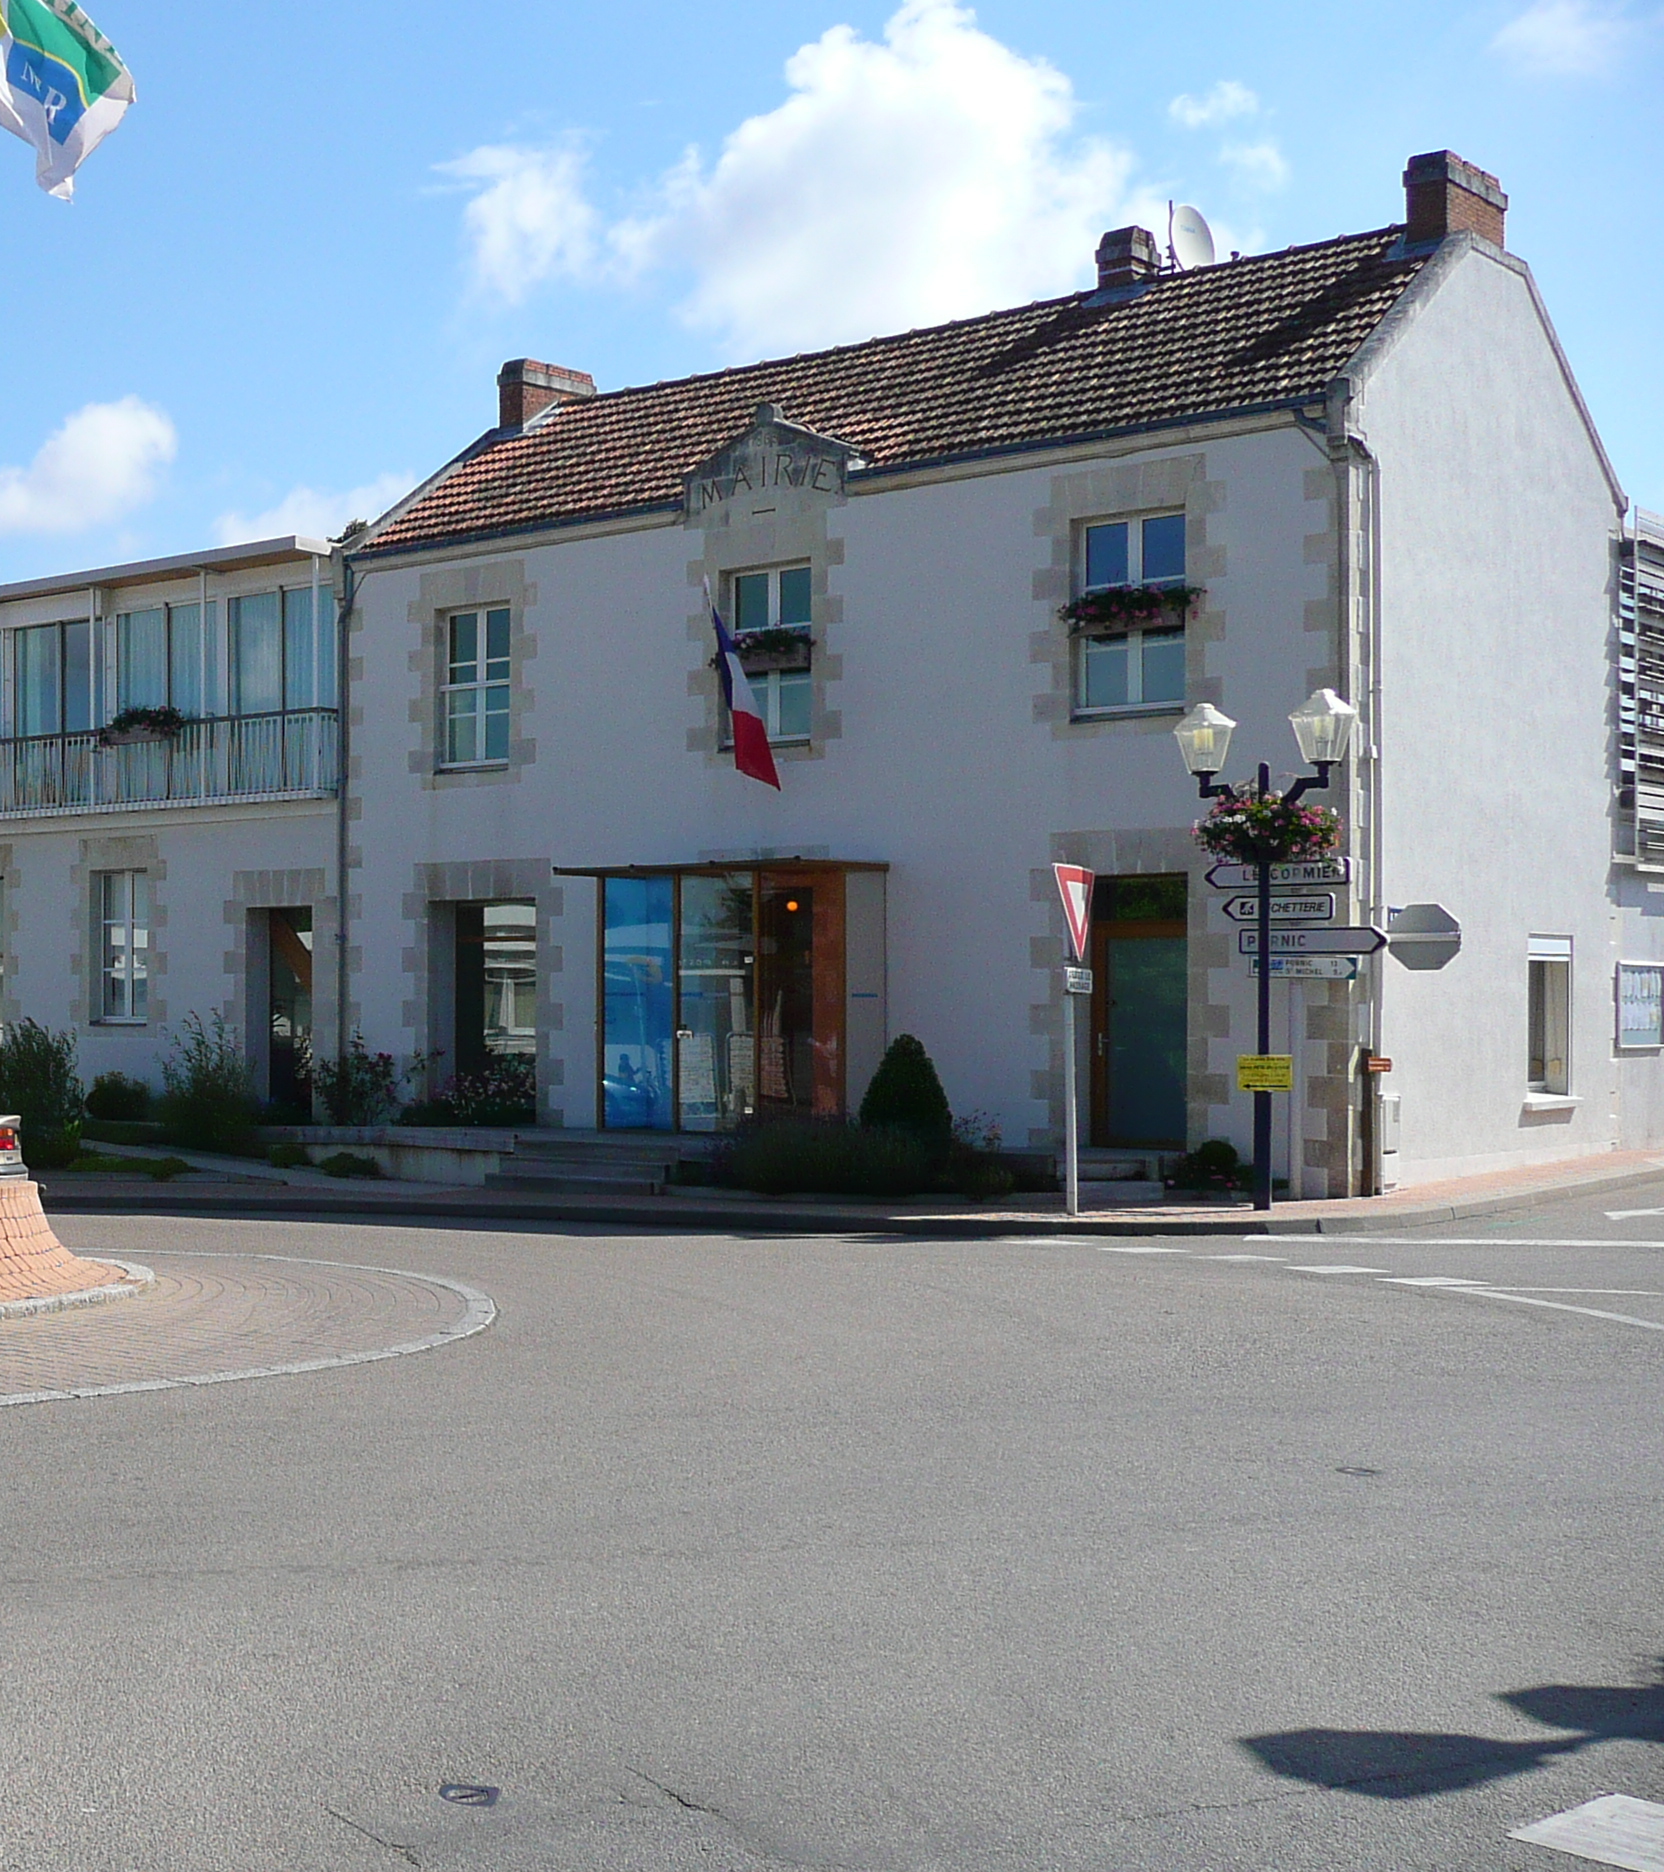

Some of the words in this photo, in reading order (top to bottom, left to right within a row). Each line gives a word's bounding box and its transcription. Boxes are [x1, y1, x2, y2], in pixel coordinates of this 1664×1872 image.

[700, 453, 836, 510] MAIRIE
[1270, 902, 1325, 914] CHETTERIE
[1247, 935, 1306, 947] PRNIC
[1285, 959, 1313, 967] PORNIC
